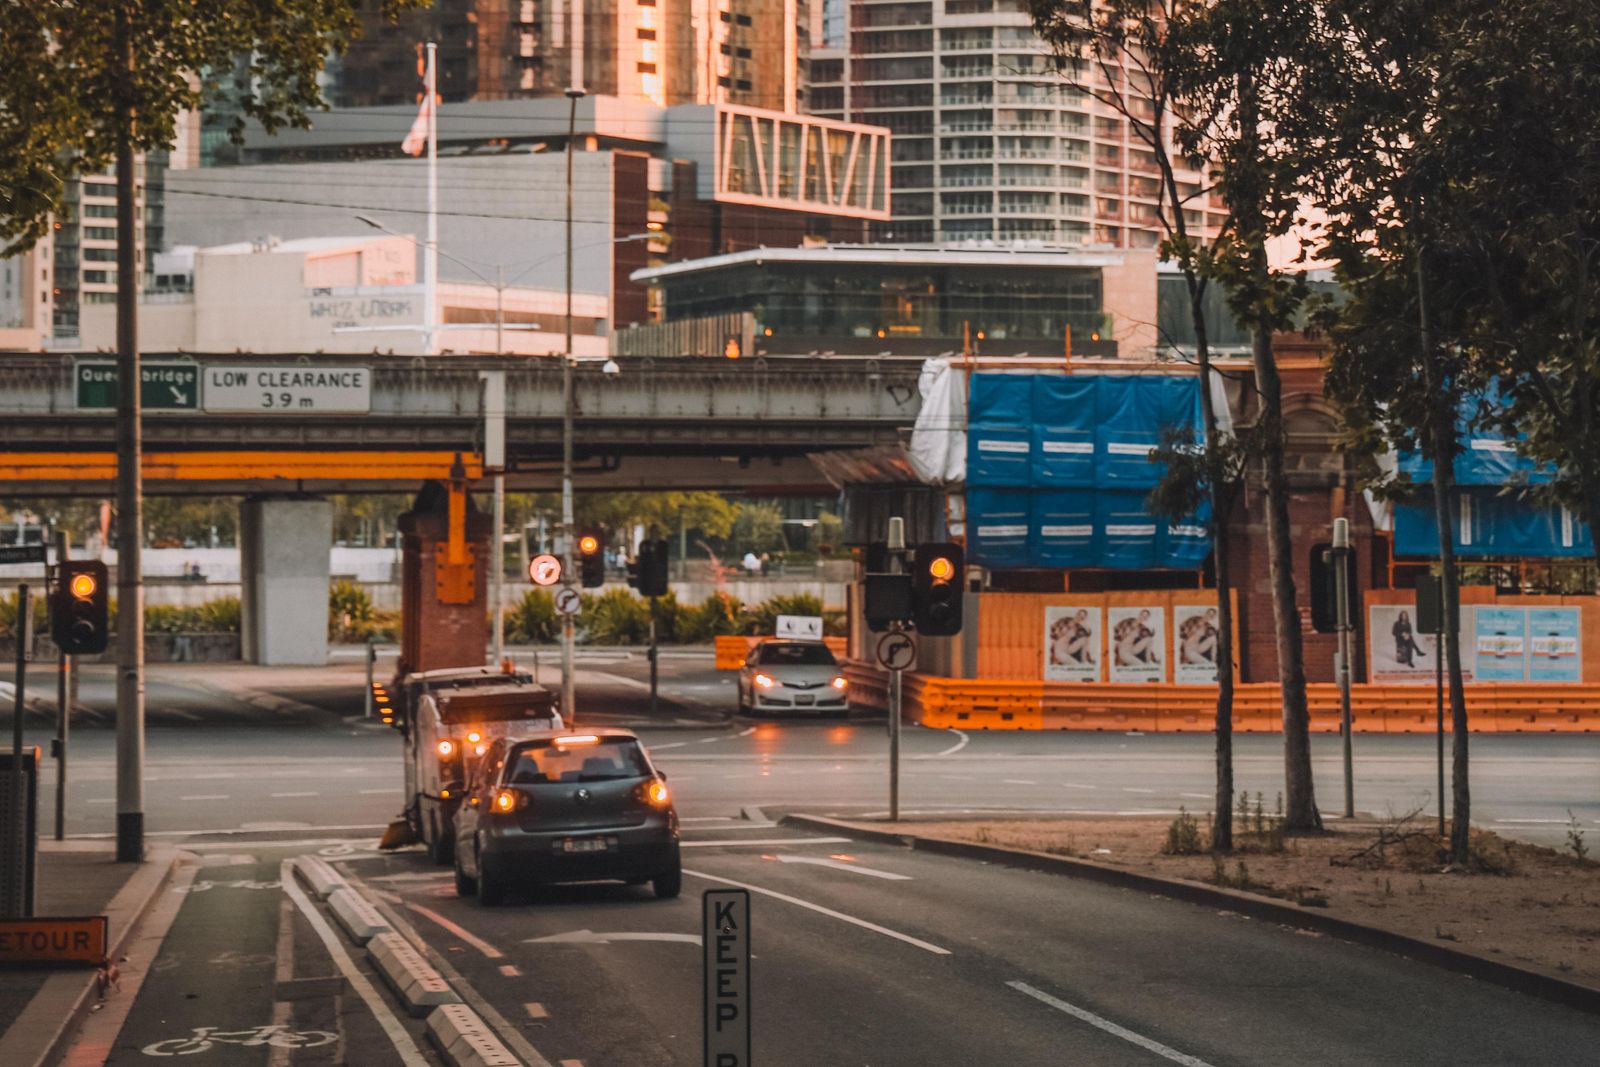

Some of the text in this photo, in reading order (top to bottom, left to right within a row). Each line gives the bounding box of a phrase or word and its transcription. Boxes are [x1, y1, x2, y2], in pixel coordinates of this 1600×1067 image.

[82, 369, 194, 386] Quebridge
[213, 371, 363, 389] LOW CLEARANCE
[262, 392, 313, 408] 3.9 m
[0, 930, 90, 952] ETOUR
[714, 901, 738, 1032] KEEP
